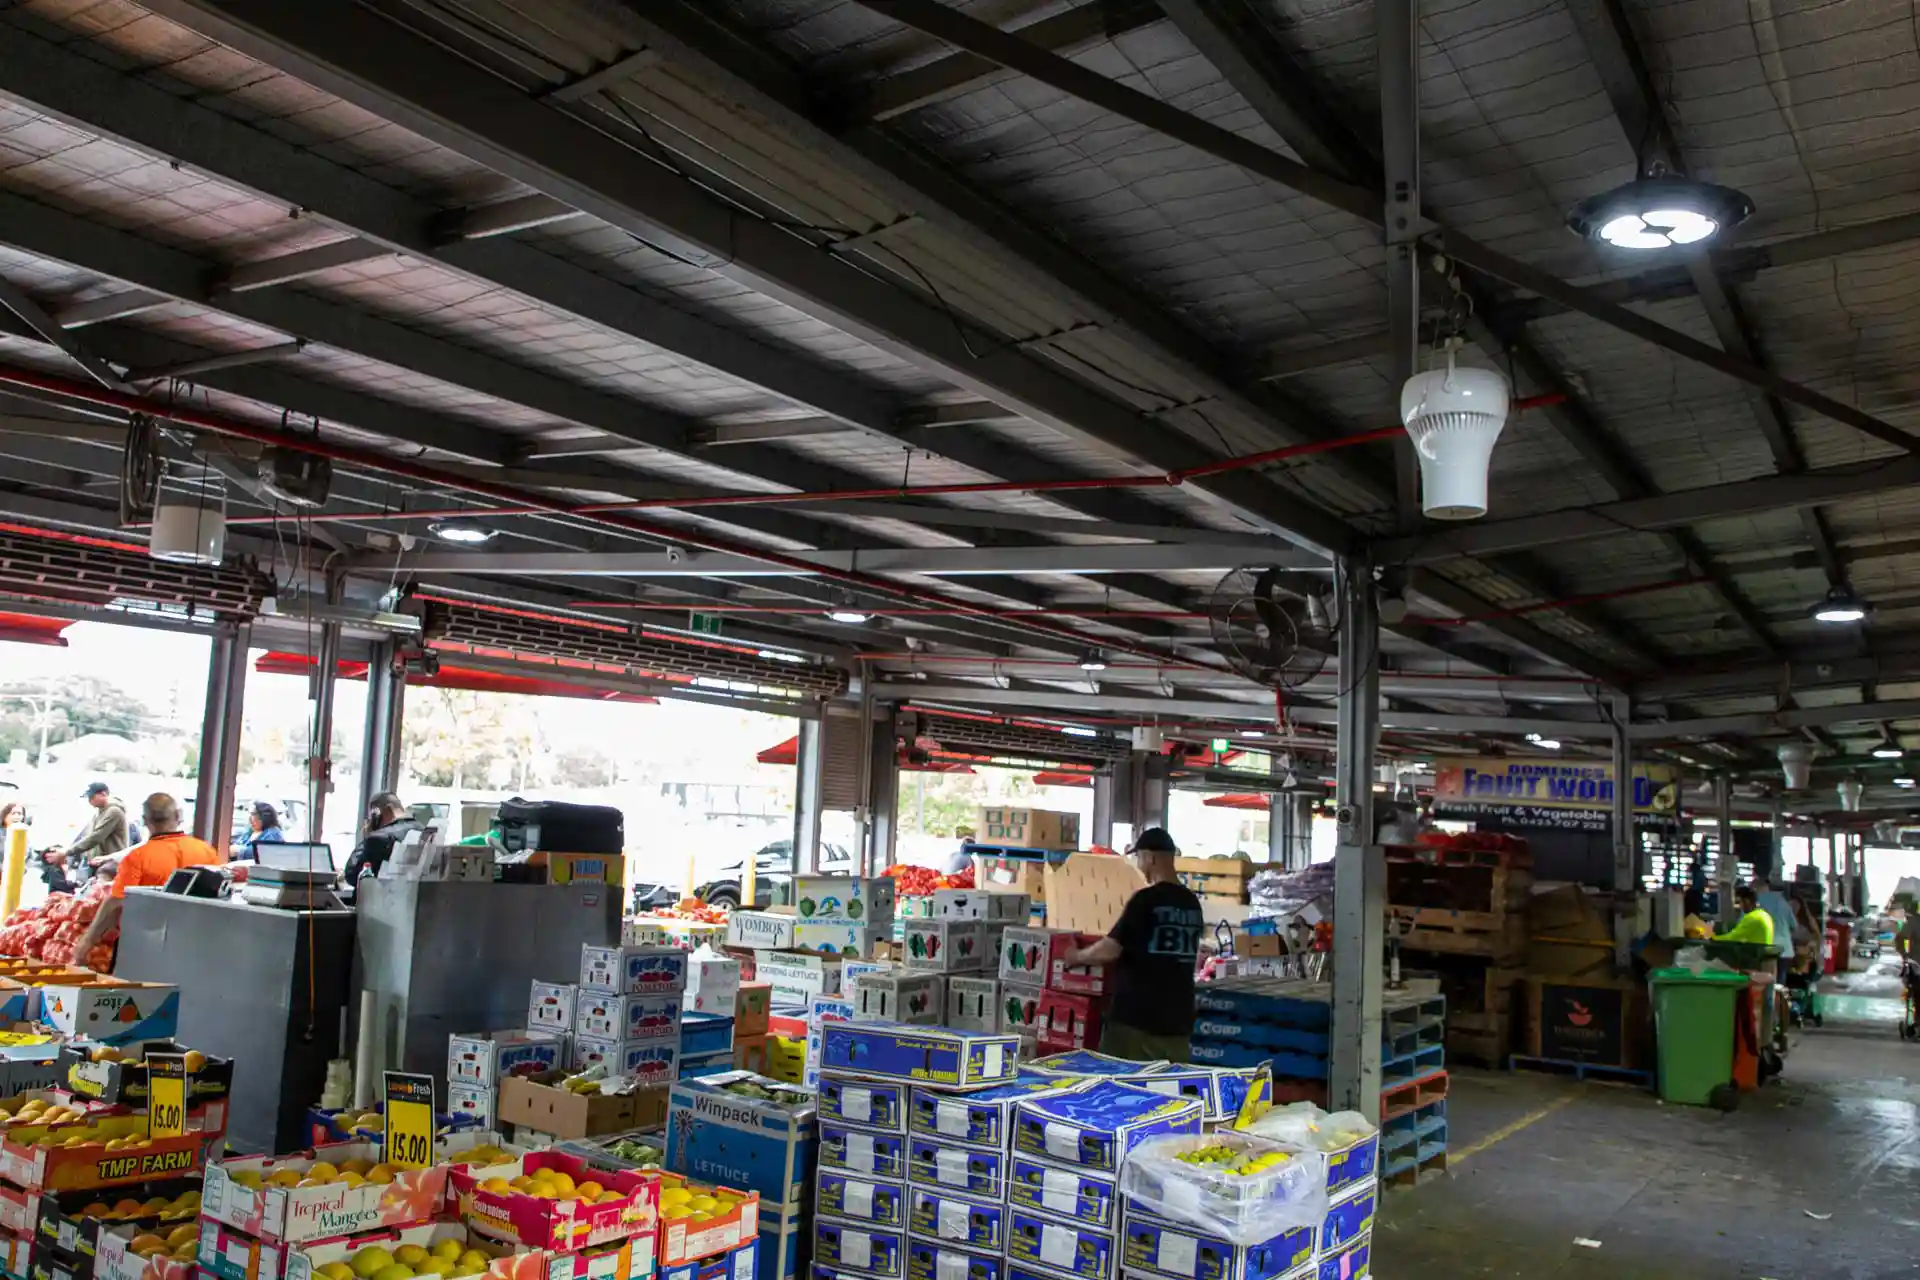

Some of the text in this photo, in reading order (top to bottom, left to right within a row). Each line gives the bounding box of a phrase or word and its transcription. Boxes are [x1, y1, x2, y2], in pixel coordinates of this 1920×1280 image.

[1464, 768, 1651, 807] FRUIT WORD
[1440, 801, 1477, 814] Fresh
[1514, 807, 1526, 817] &
[1531, 807, 1607, 821] Vegetable
[735, 916, 785, 936] WOMBOK
[412, 1083, 431, 1096] Fresh
[153, 1104, 181, 1130] 15.00
[694, 1095, 760, 1127] Winpack
[393, 1132, 427, 1165] 15.00
[98, 1150, 193, 1181] TMP FARM
[694, 1157, 750, 1185] LETTUCE
[293, 1191, 345, 1222] Tropical
